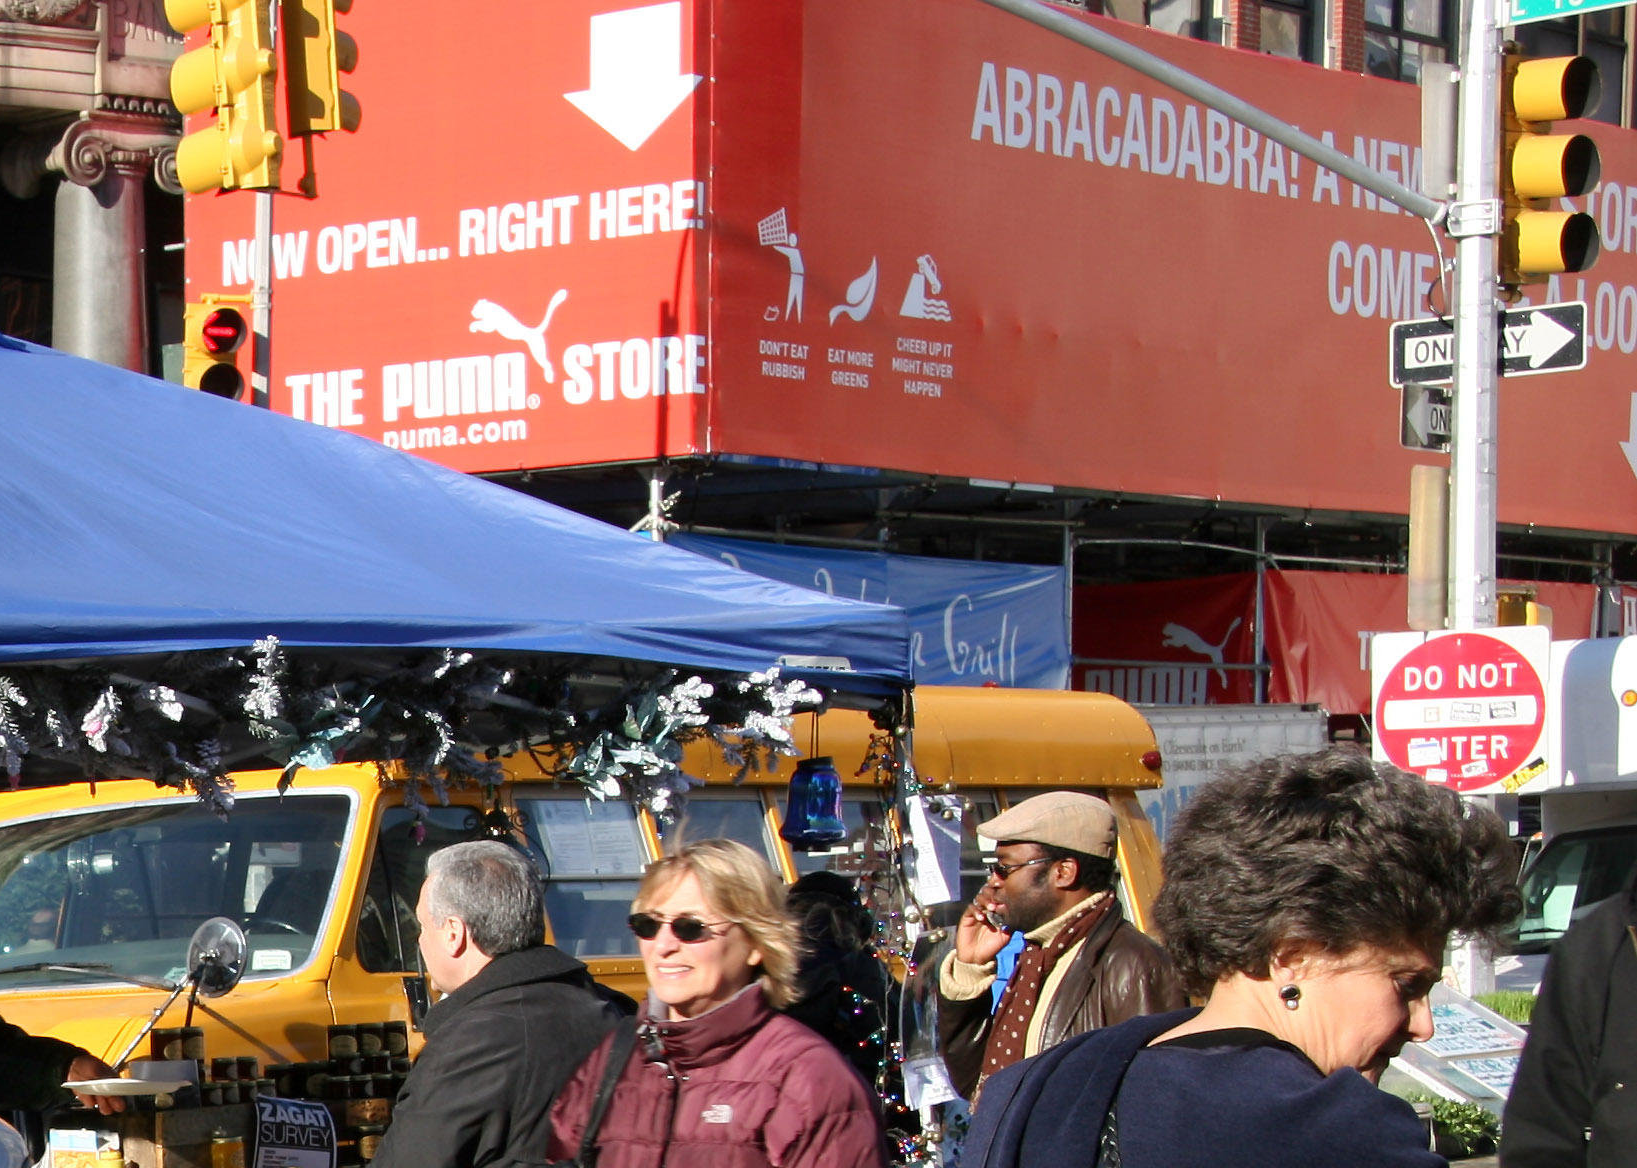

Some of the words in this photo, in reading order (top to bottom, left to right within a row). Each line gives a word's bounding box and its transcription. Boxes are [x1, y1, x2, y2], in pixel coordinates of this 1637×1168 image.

[971, 62, 1299, 199] ABRACADABRA!
[317, 216, 449, 274] OPEN...
[459, 195, 580, 257] RIGHT
[589, 179, 705, 241] HERE!
[1327, 240, 1435, 320] COME
[759, 340, 788, 358] DON'T
[791, 344, 809, 361] EAT
[827, 348, 846, 364] EAT
[847, 351, 874, 368] MORE
[896, 337, 927, 355] CHEER
[929, 341, 941, 357] UP
[943, 344, 953, 358] IT
[1414, 337, 1453, 364] ON
[762, 361, 806, 380] RUBBISH
[831, 371, 869, 388] GREENS
[892, 357, 921, 374] MIGHT
[923, 361, 953, 379] NEVER
[285, 369, 364, 429] THE
[563, 334, 706, 405] STORE
[904, 380, 941, 398] HAPPEN
[383, 418, 527, 450] puma.com
[1404, 665, 1443, 692] DO
[1458, 662, 1518, 689] NOT
[1409, 735, 1509, 762] NTER
[259, 1102, 327, 1128] ZAGAT
[260, 1123, 332, 1148] SURVEY
